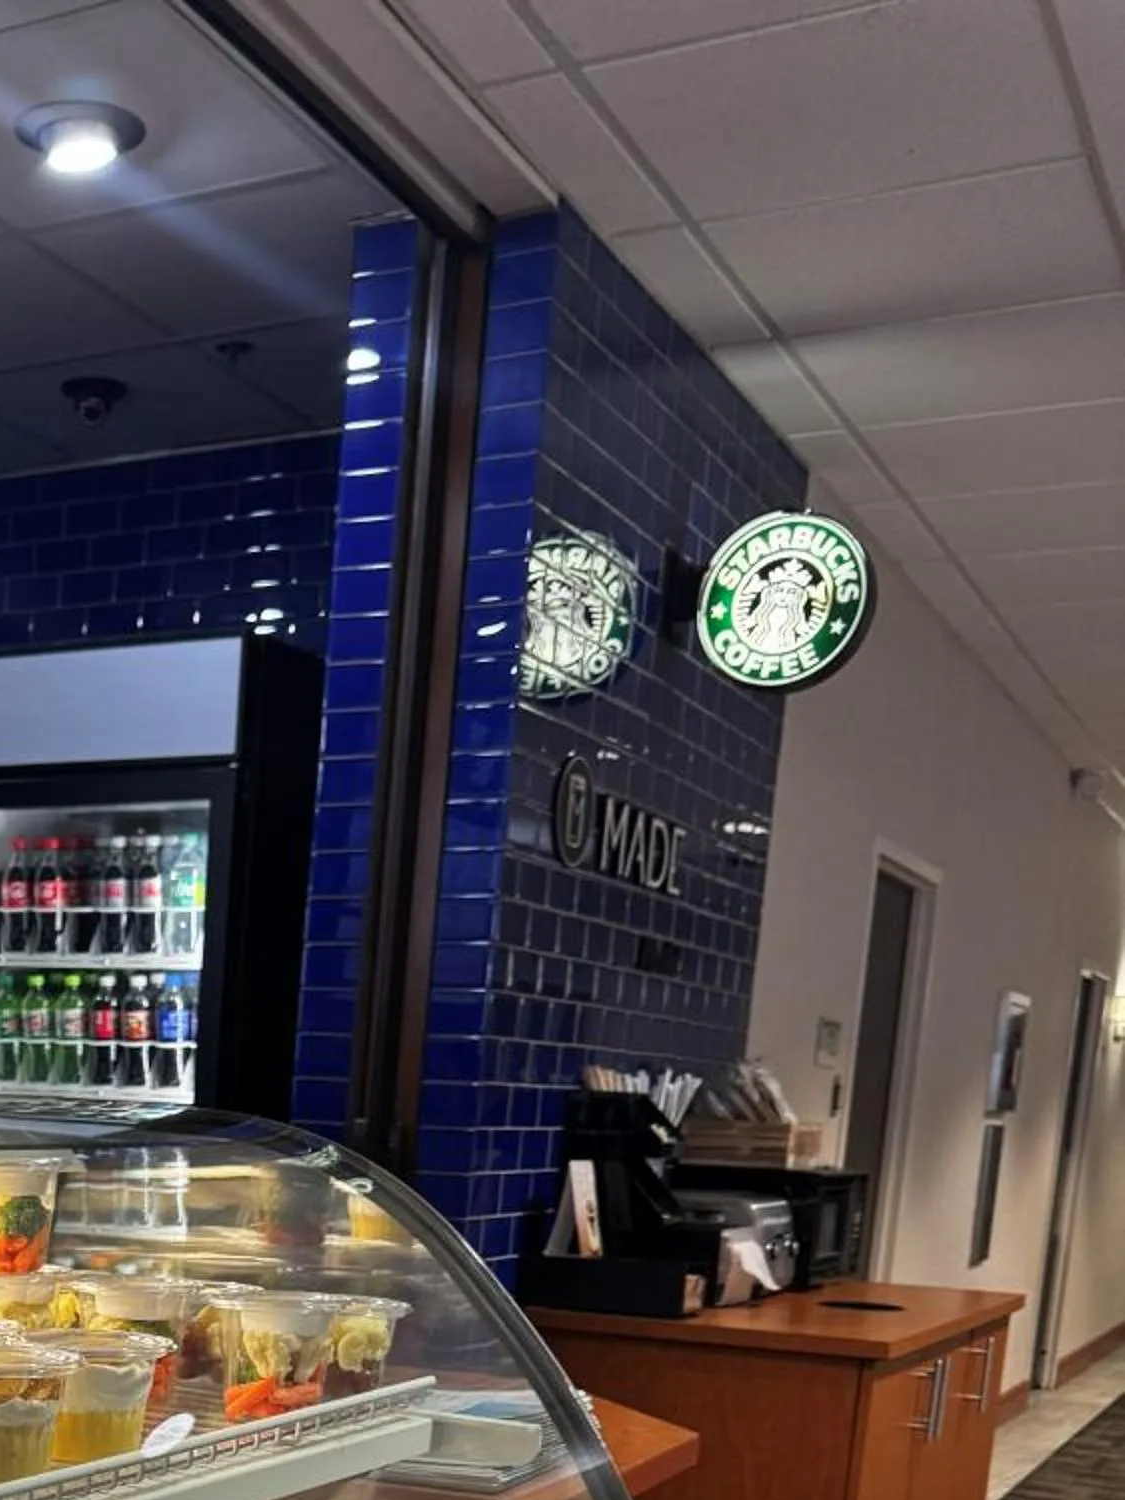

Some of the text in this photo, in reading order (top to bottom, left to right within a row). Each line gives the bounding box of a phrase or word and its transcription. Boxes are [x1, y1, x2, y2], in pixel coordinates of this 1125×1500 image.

[717, 525, 860, 604] STARBUCKS
[714, 629, 820, 679] COFFEE
[599, 797, 688, 896] MADE
